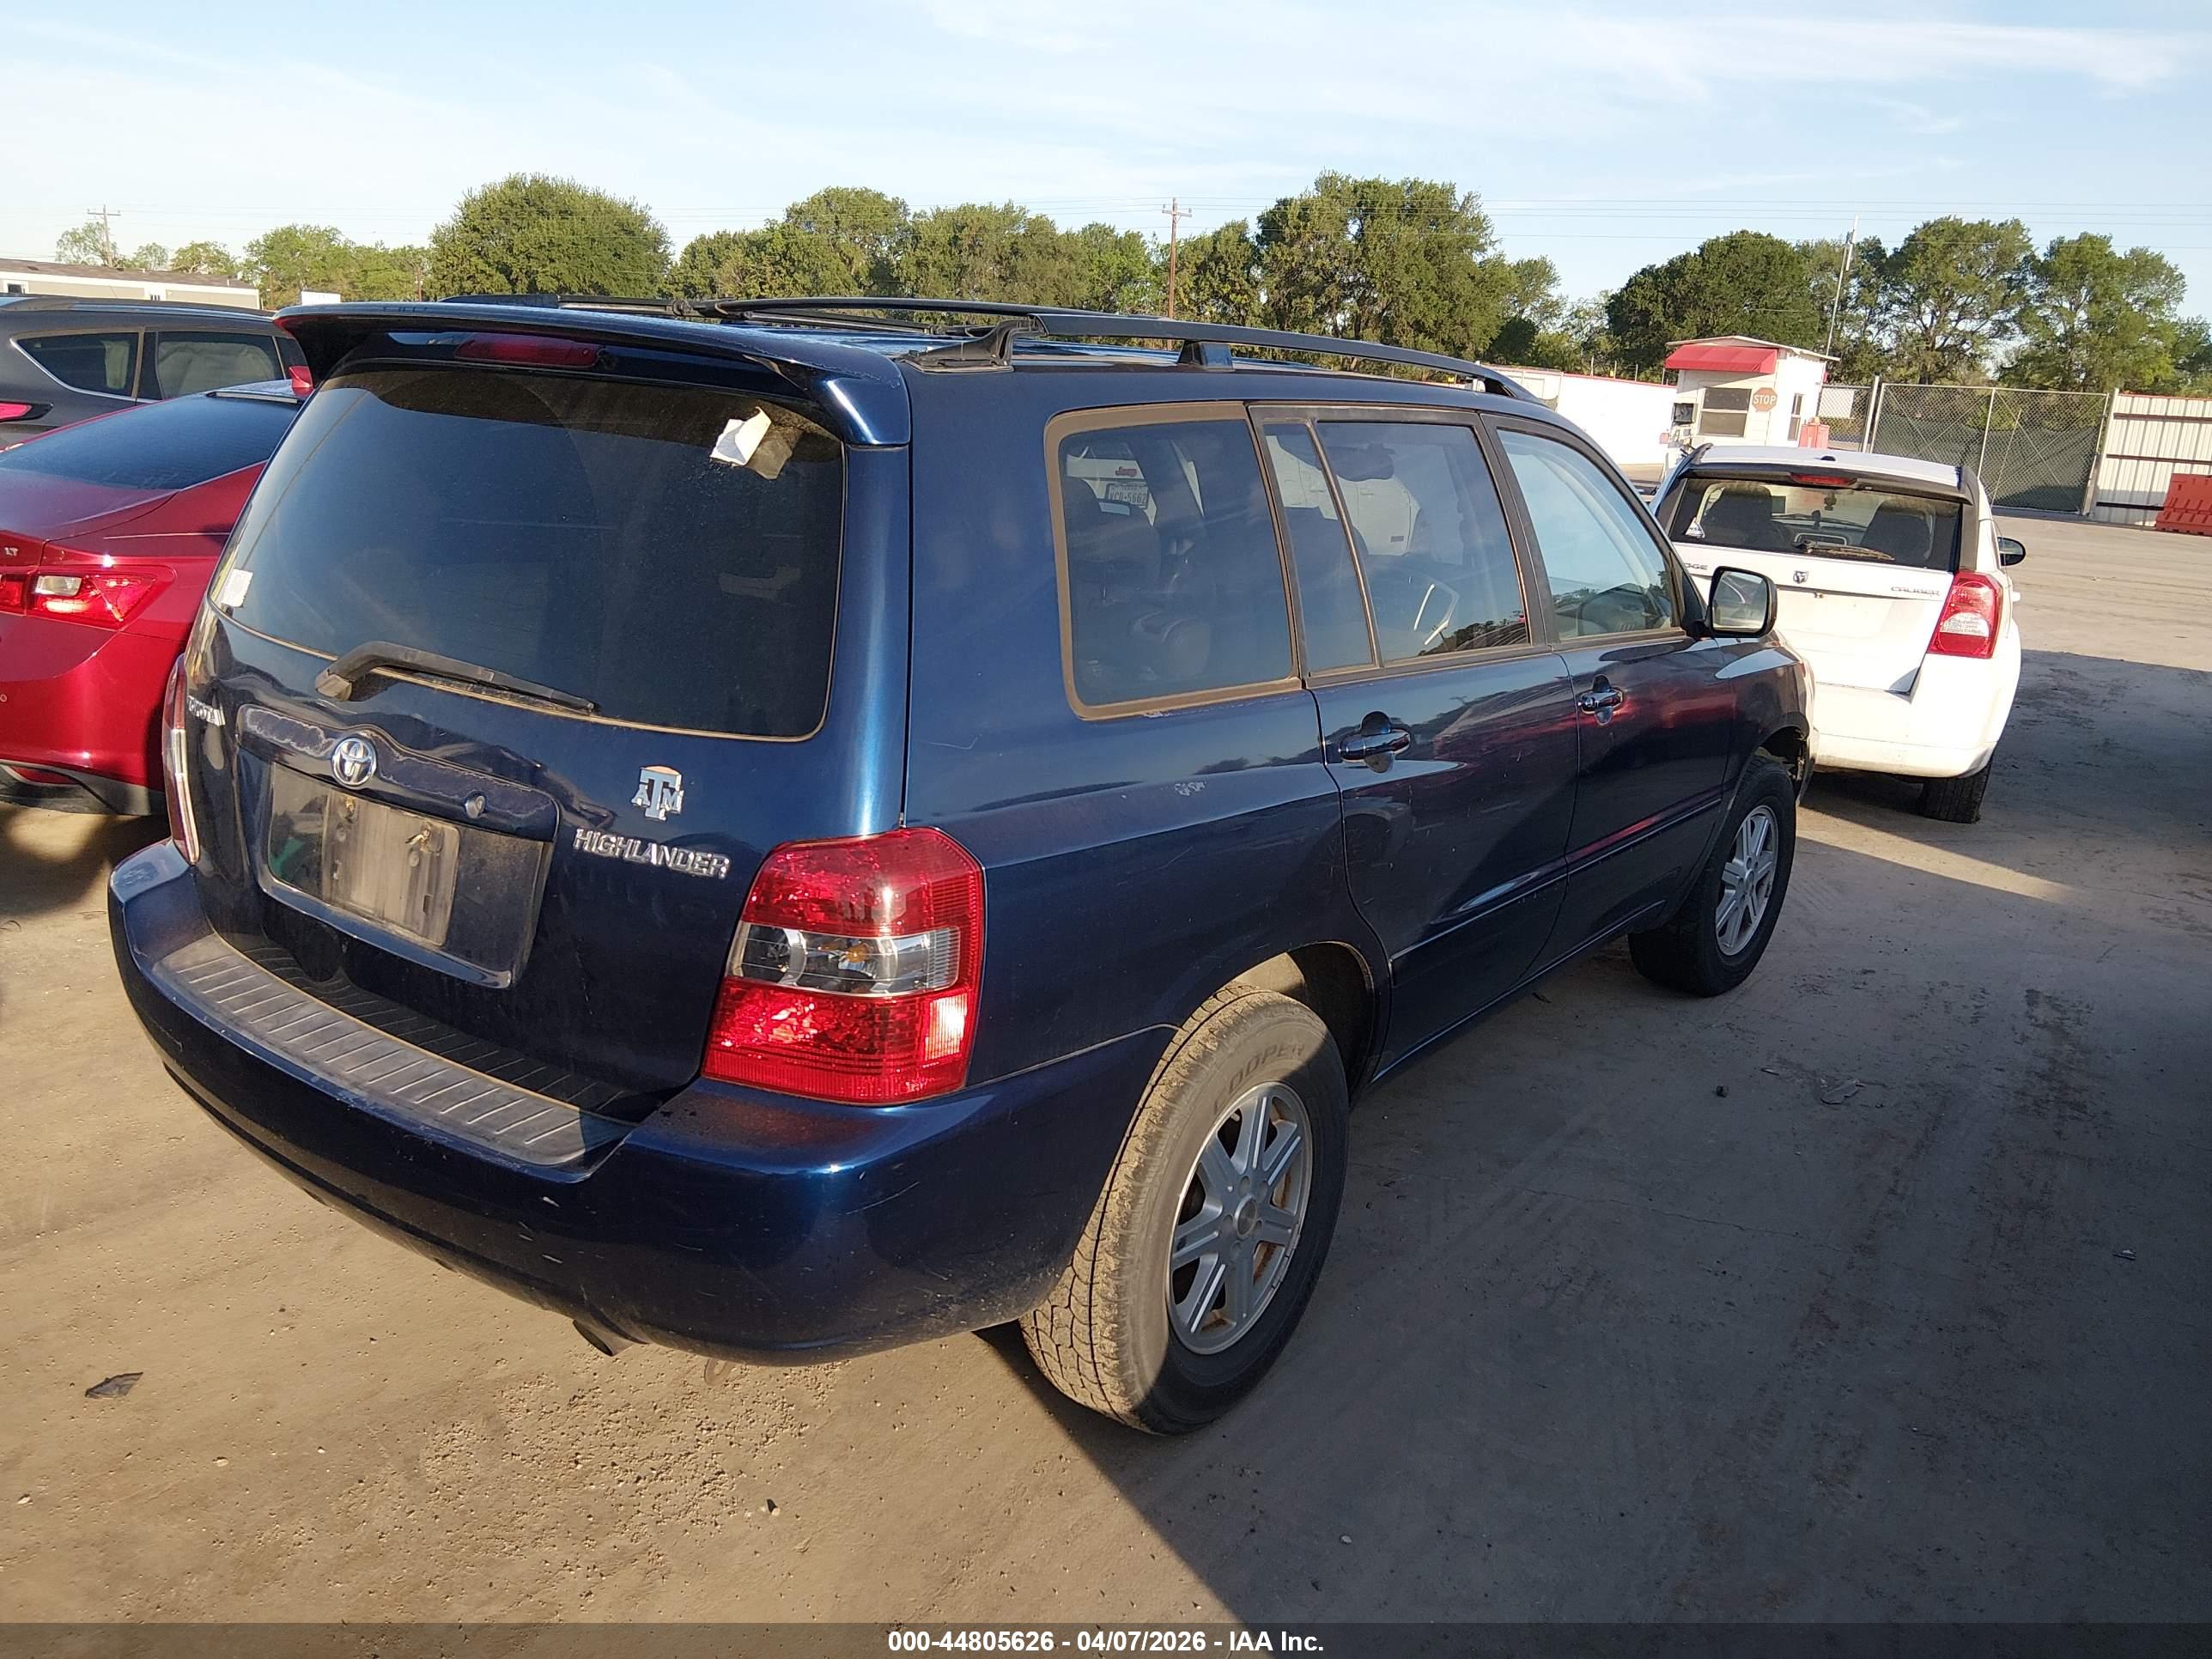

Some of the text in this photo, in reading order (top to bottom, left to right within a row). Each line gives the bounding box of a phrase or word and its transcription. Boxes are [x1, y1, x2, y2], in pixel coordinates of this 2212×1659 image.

[1753, 394, 1777, 404] STOP
[1115, 466, 1137, 477] Jeep
[4, 547, 18, 556] LT
[573, 829, 730, 878] HIGHLANDER
